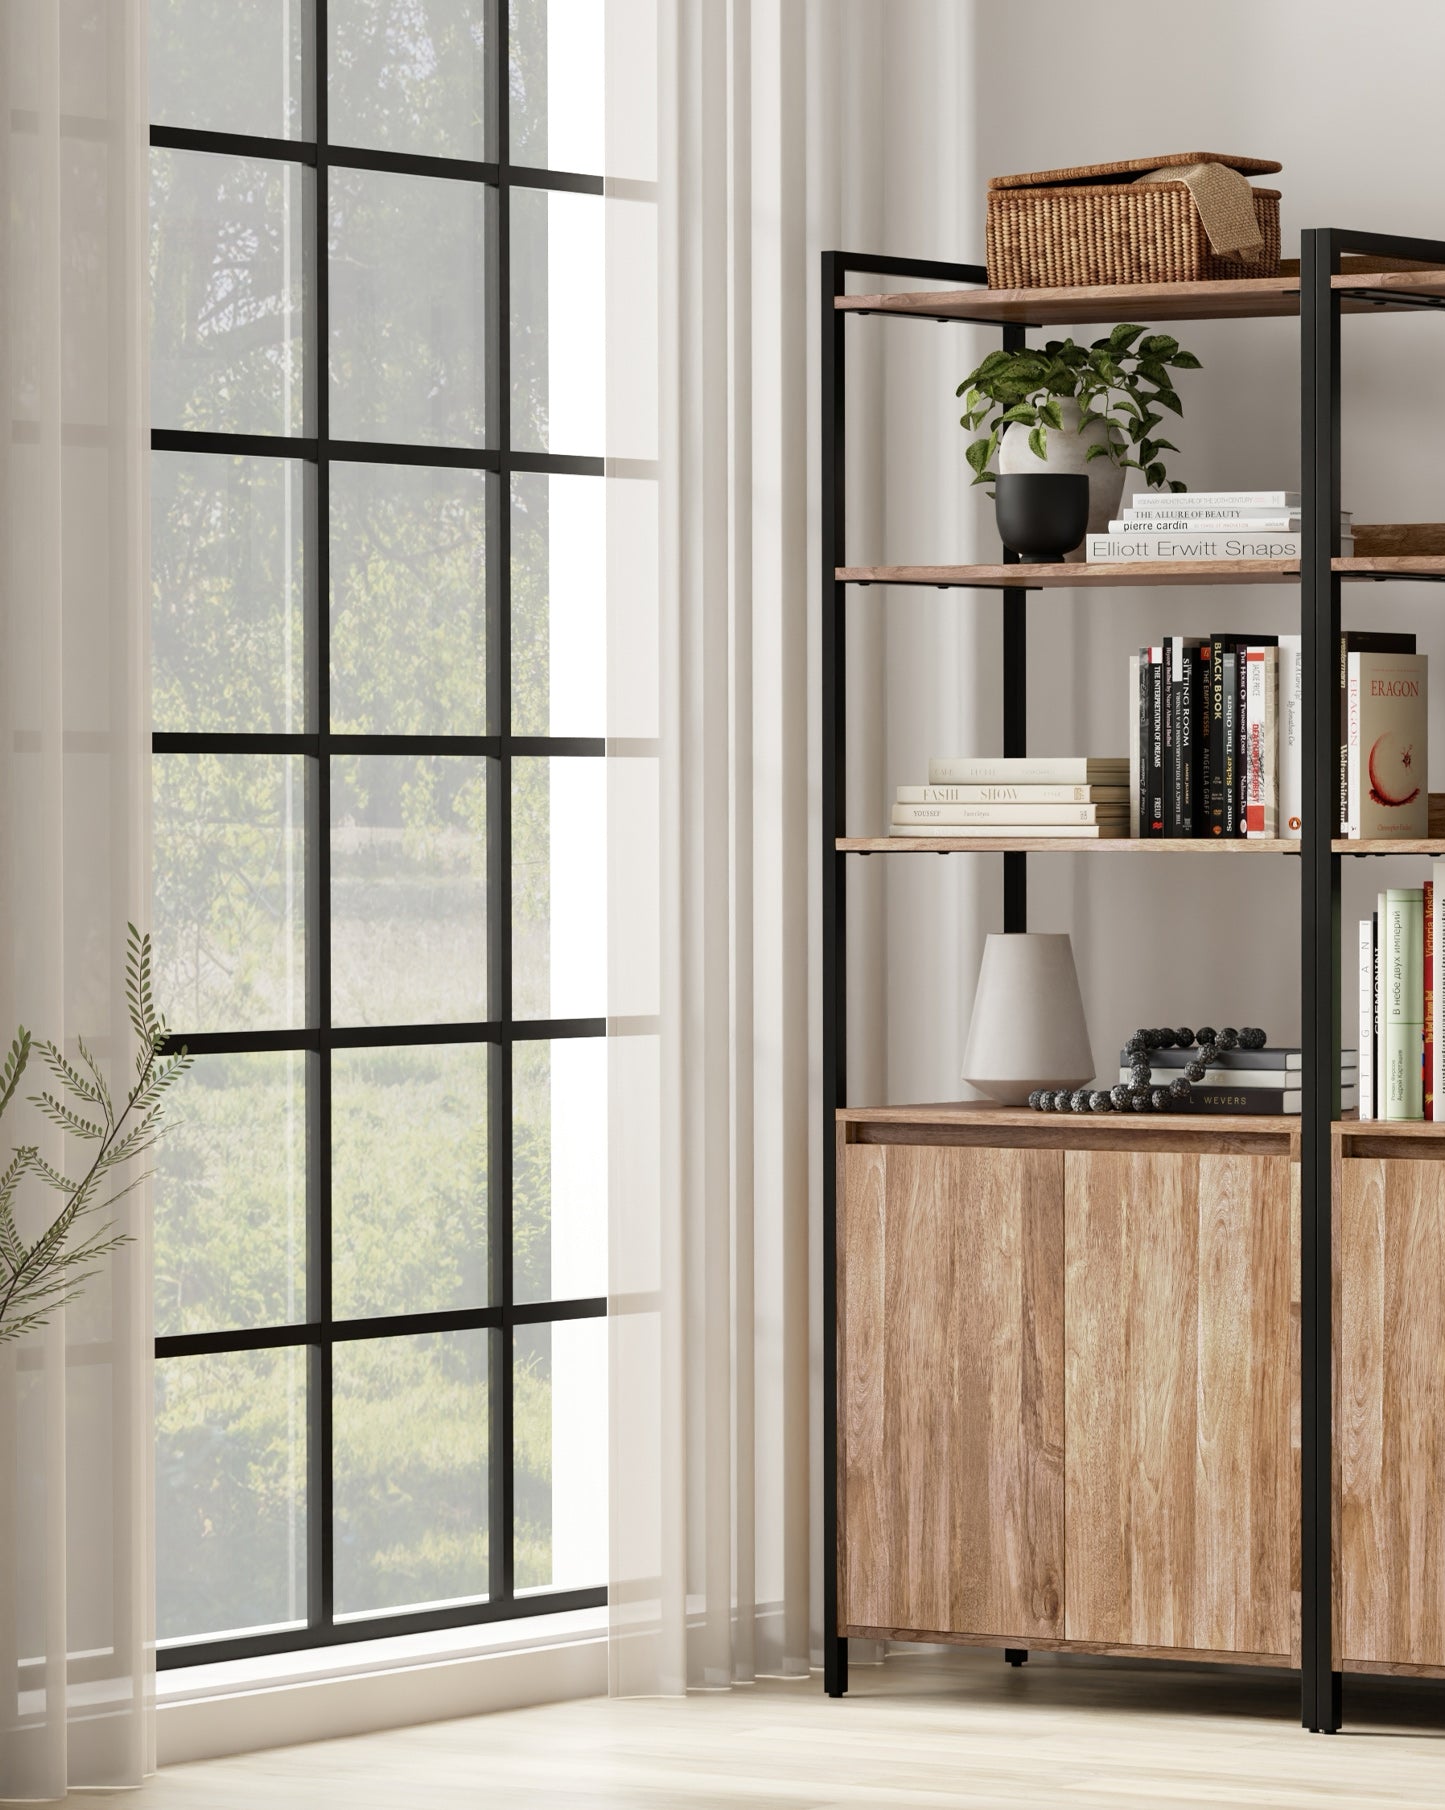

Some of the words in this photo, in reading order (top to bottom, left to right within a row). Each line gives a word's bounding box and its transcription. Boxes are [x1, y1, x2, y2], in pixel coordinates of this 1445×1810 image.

[1124, 522, 1153, 532] pierre
[1156, 521, 1188, 530] cardin
[1135, 511, 1153, 519] THE
[1154, 511, 1190, 519] ALLURE
[1205, 510, 1241, 518] BEAUTY
[1093, 541, 1149, 557] Elliott
[1157, 541, 1217, 556] Erwitt
[1226, 540, 1296, 558] Snaps
[1214, 642, 1222, 682] BLACK
[1371, 680, 1419, 697] ERAGON
[1214, 684, 1222, 720] BOOK
[1350, 679, 1358, 746] ERAGON
[1154, 732, 1161, 741] OF
[1425, 886, 1433, 918] Mosley
[1393, 910, 1402, 954] империй
[1425, 922, 1433, 958] Victoria
[1393, 956, 1402, 980] двух
[1393, 982, 1402, 1006] небе
[1361, 922, 1370, 1120] PITIGLIANI
[1204, 1096, 1247, 1105] WEVERS
